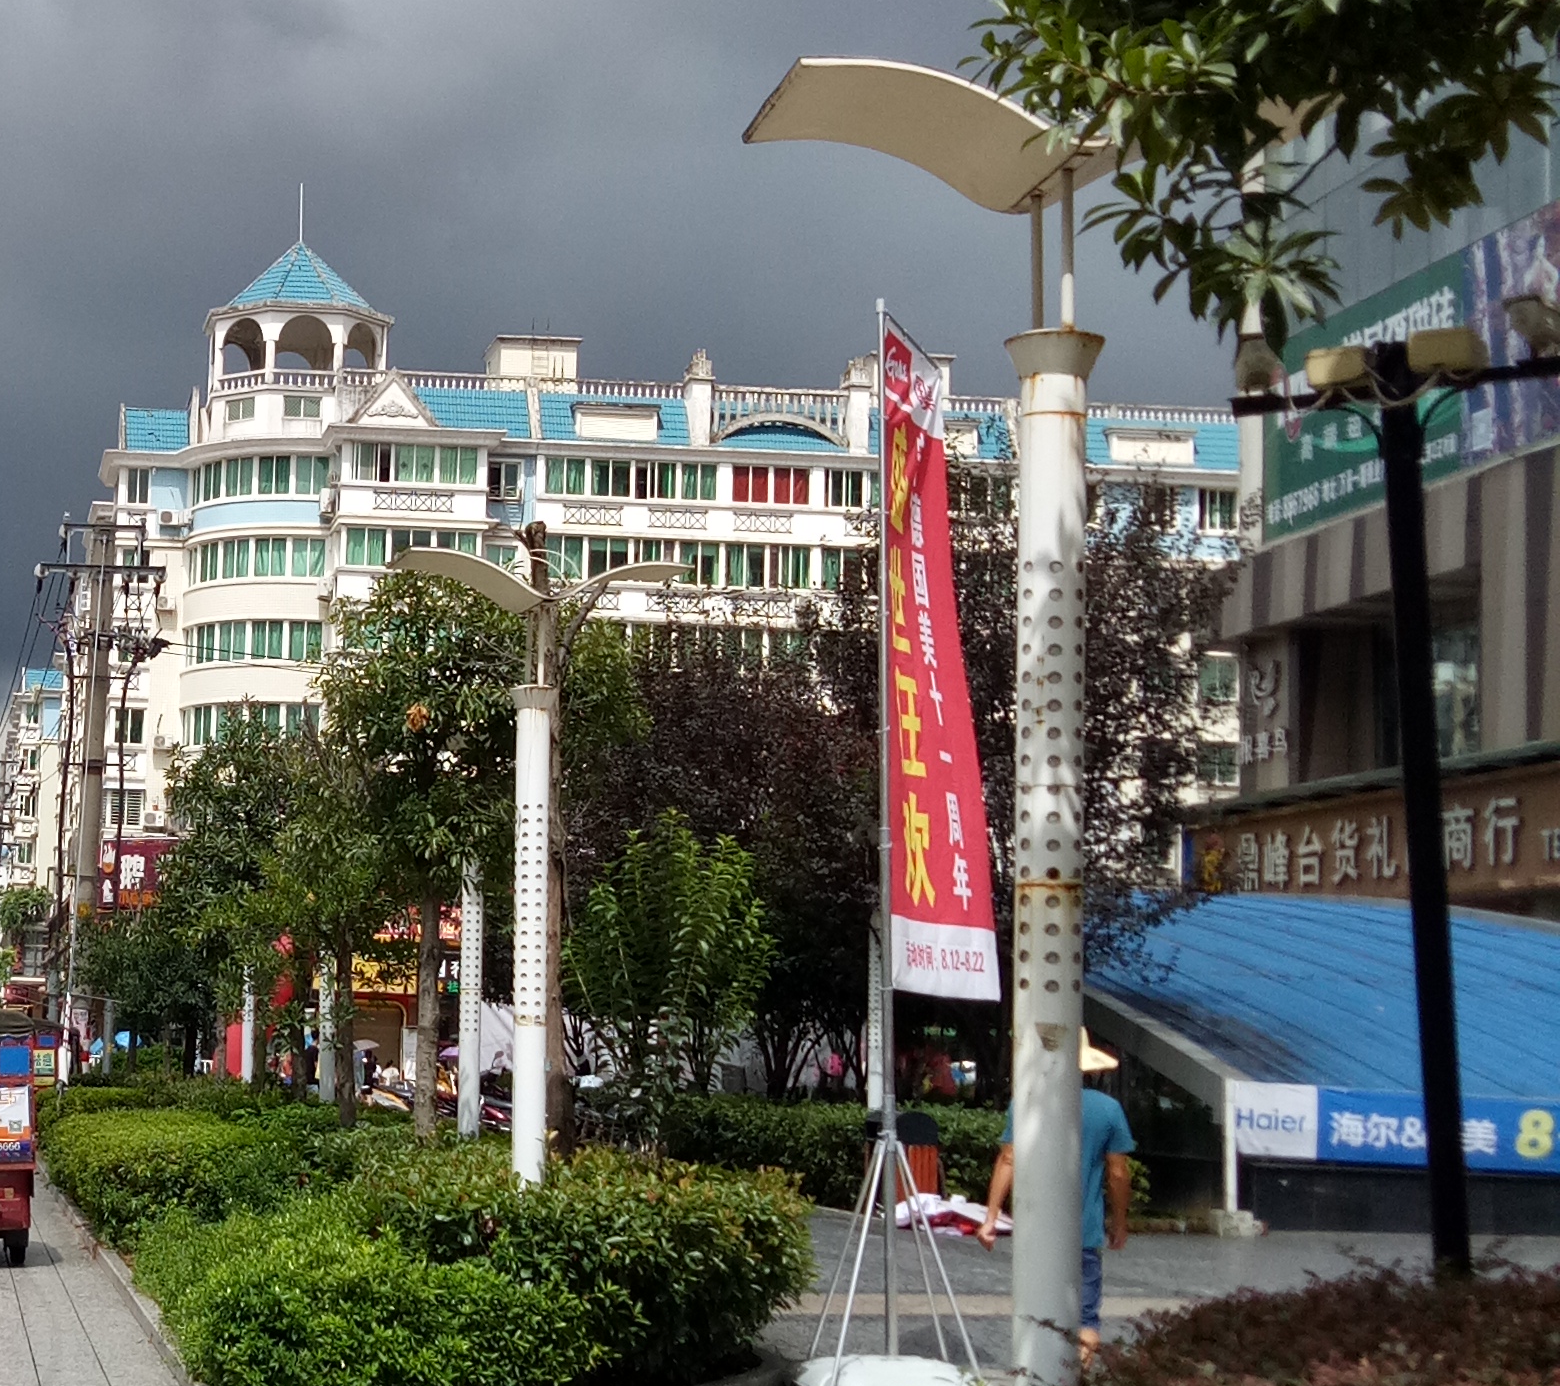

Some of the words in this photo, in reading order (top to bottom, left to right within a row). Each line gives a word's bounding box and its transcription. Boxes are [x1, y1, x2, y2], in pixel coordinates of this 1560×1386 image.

[1237, 797, 1520, 891] 鼎峰台货礼商行
[1234, 1107, 1306, 1134] Haier
